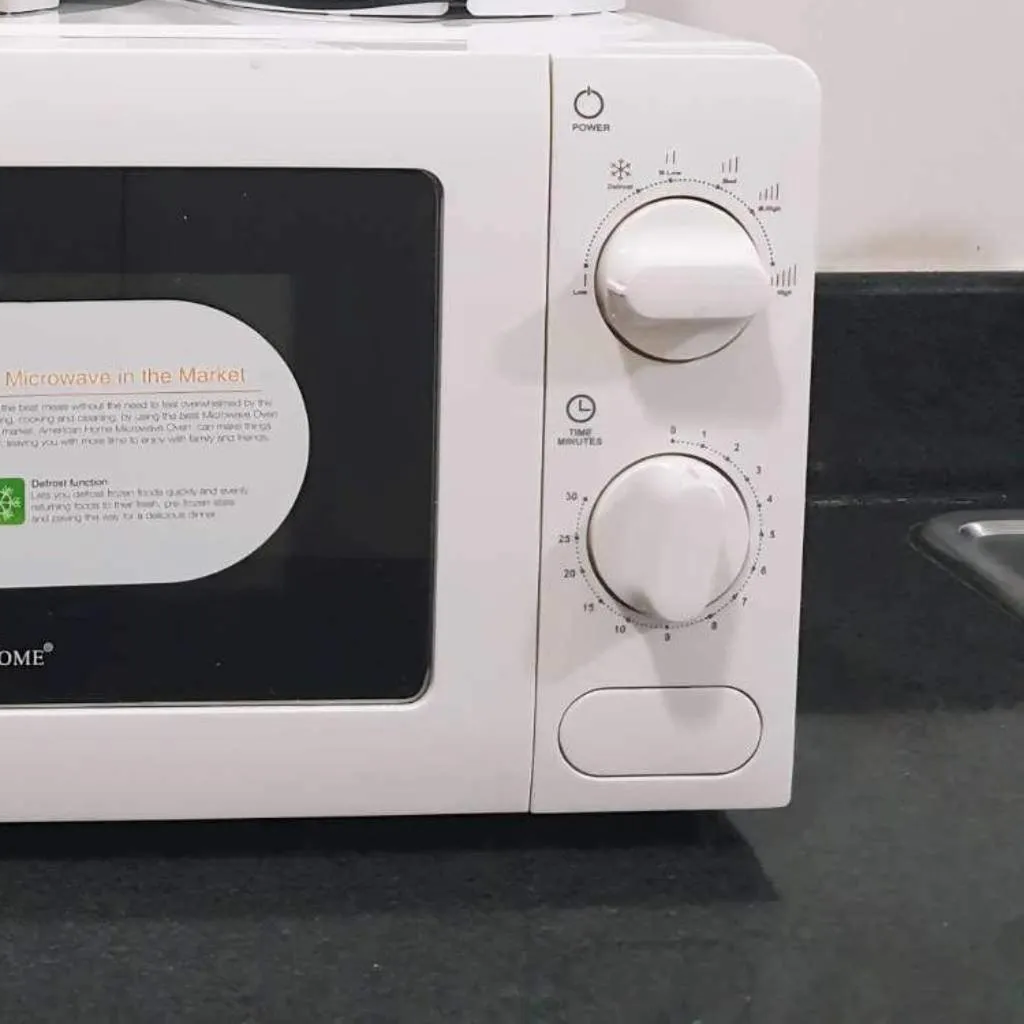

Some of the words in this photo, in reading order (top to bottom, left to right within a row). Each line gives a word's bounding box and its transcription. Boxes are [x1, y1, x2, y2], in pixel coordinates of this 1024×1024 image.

[572, 123, 610, 132] POWER
[5, 370, 111, 386] Microwave
[118, 369, 135, 384] in
[142, 368, 172, 383] the
[179, 367, 245, 383] Market
[569, 428, 592, 436] TIME
[670, 426, 677, 435] 0
[702, 430, 707, 438] 1
[557, 437, 603, 446] MINUTES
[734, 443, 740, 452] 2
[756, 466, 762, 474] 3
[31, 478, 66, 488] Defrost
[70, 478, 108, 487] function
[566, 492, 578, 501] 30
[766, 495, 773, 503] 4
[770, 530, 776, 539] 5
[558, 535, 570, 544] 25
[564, 569, 576, 578] 20
[760, 566, 766, 575] 6
[742, 597, 748, 607] 7
[583, 603, 594, 612] 15
[615, 625, 626, 634] 10
